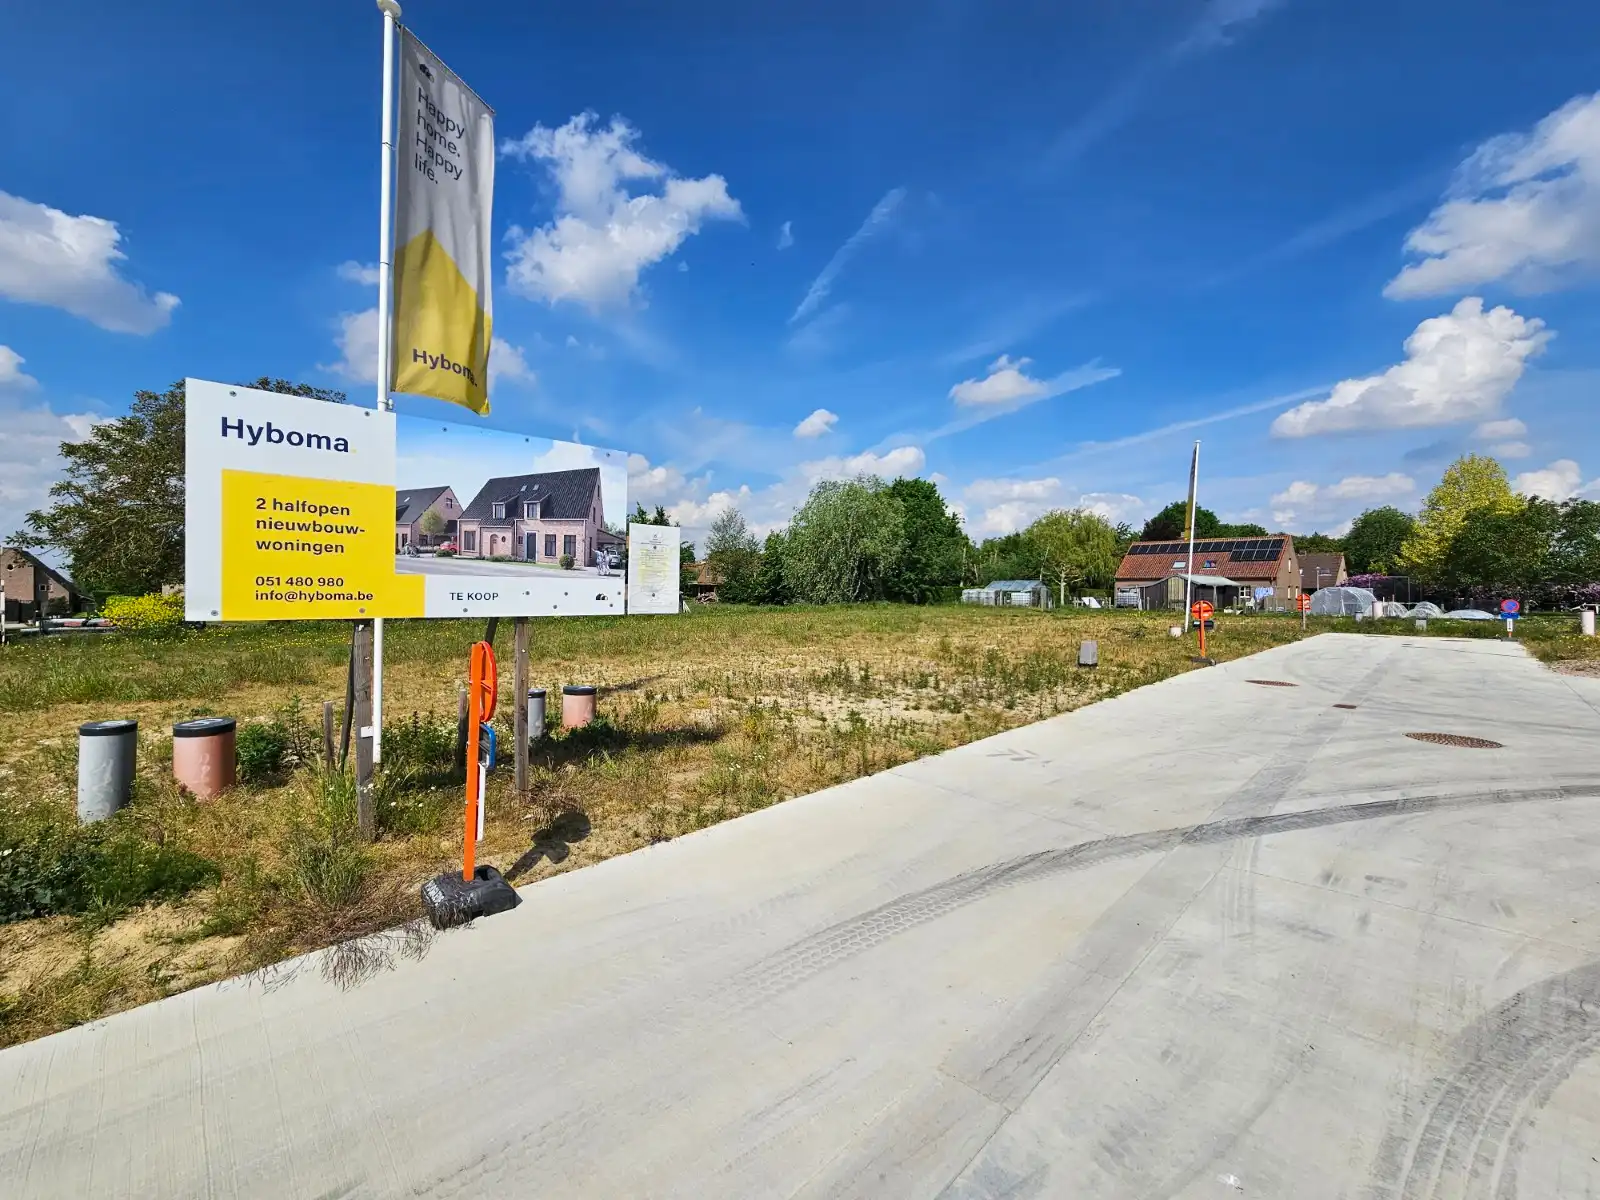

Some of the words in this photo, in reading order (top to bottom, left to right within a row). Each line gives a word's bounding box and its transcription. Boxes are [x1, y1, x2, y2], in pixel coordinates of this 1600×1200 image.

[418, 87, 465, 139] Happy
[417, 109, 461, 158] home.
[416, 132, 463, 181] Happy
[414, 152, 438, 185] life.
[256, 498, 266, 510] 2
[272, 498, 350, 517] halfopen
[256, 517, 365, 535] nieuwbouw-
[256, 539, 344, 555] woningen
[255, 576, 281, 586] 051
[285, 577, 314, 587] 480
[317, 577, 345, 587] 980
[255, 590, 374, 603] info@hyboma.be
[449, 592, 464, 601] TE
[467, 592, 499, 601] KOOP
